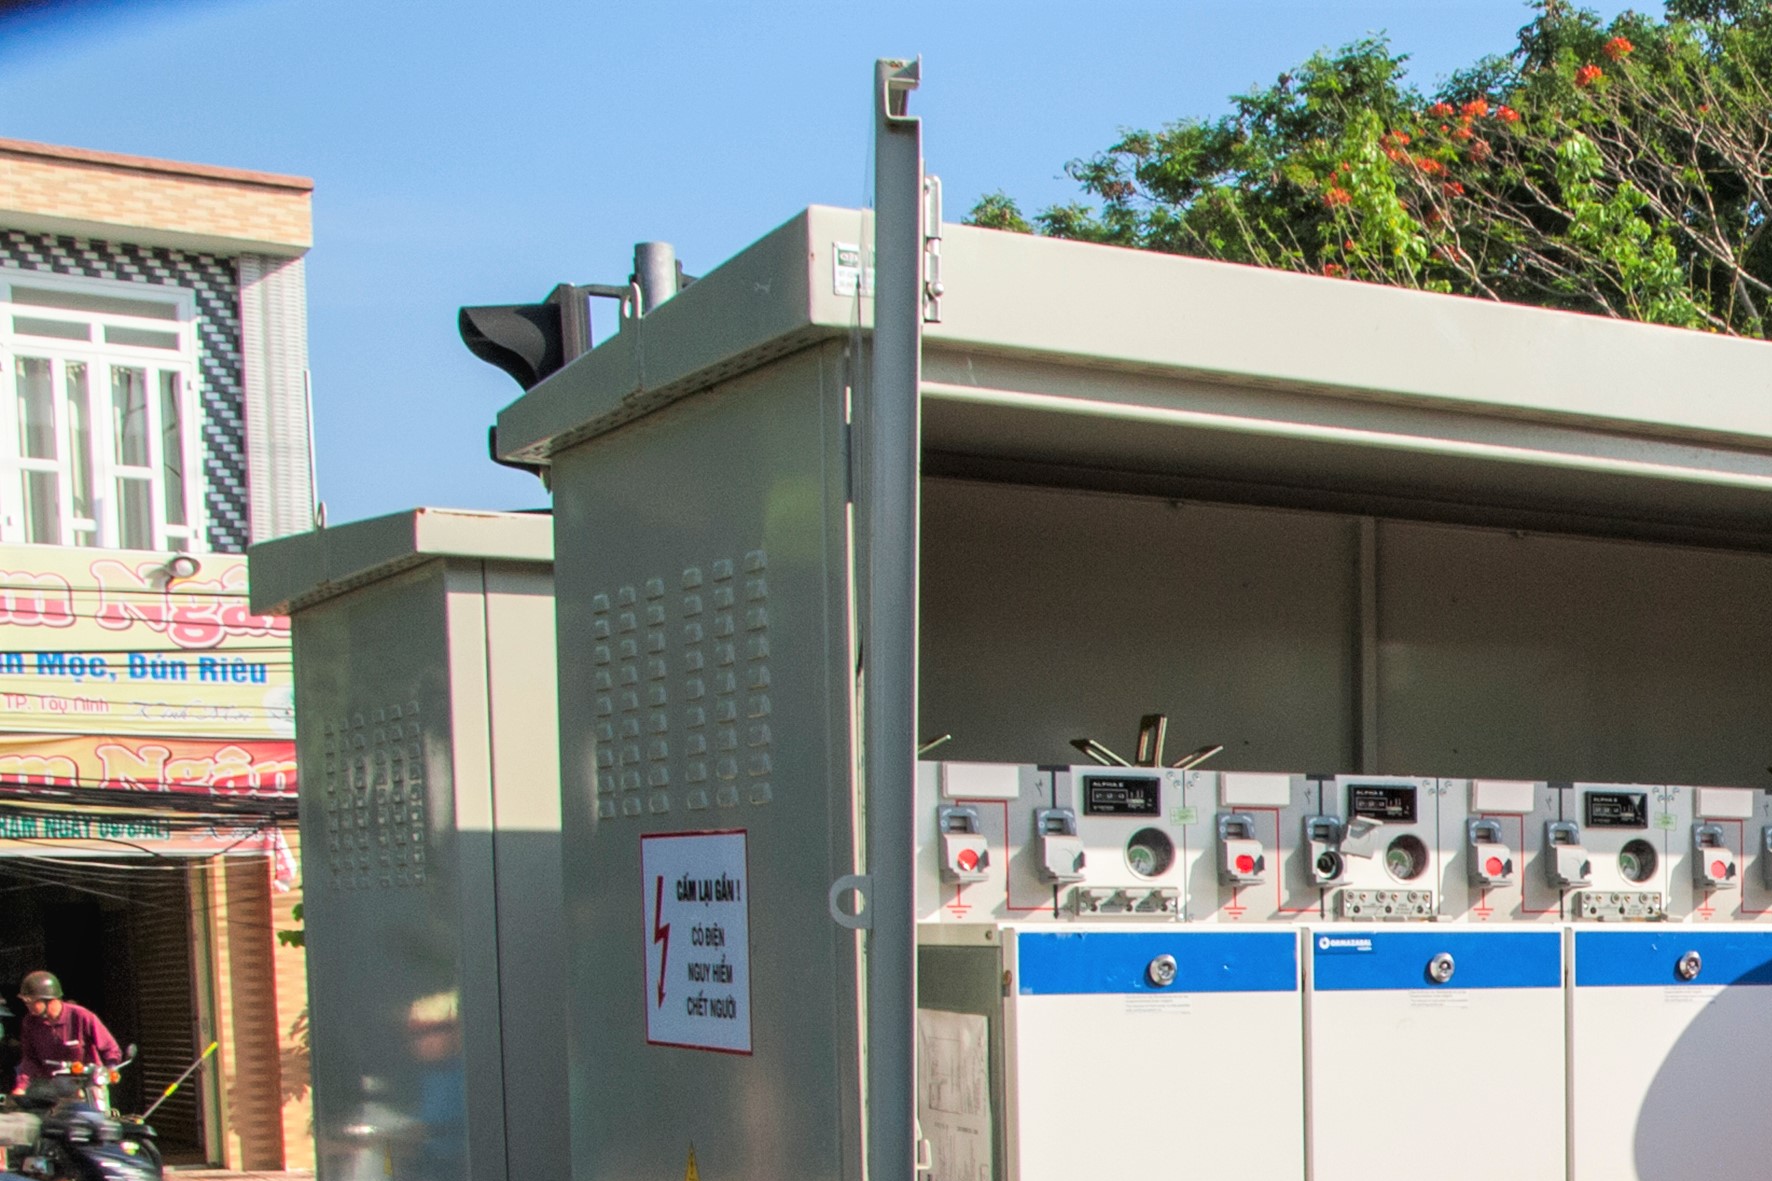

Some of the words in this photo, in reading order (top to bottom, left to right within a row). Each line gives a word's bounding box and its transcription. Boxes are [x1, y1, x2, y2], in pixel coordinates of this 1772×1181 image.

[128, 652, 188, 680] Bún
[199, 657, 267, 684] Riêu
[688, 963, 711, 983] NGUY
